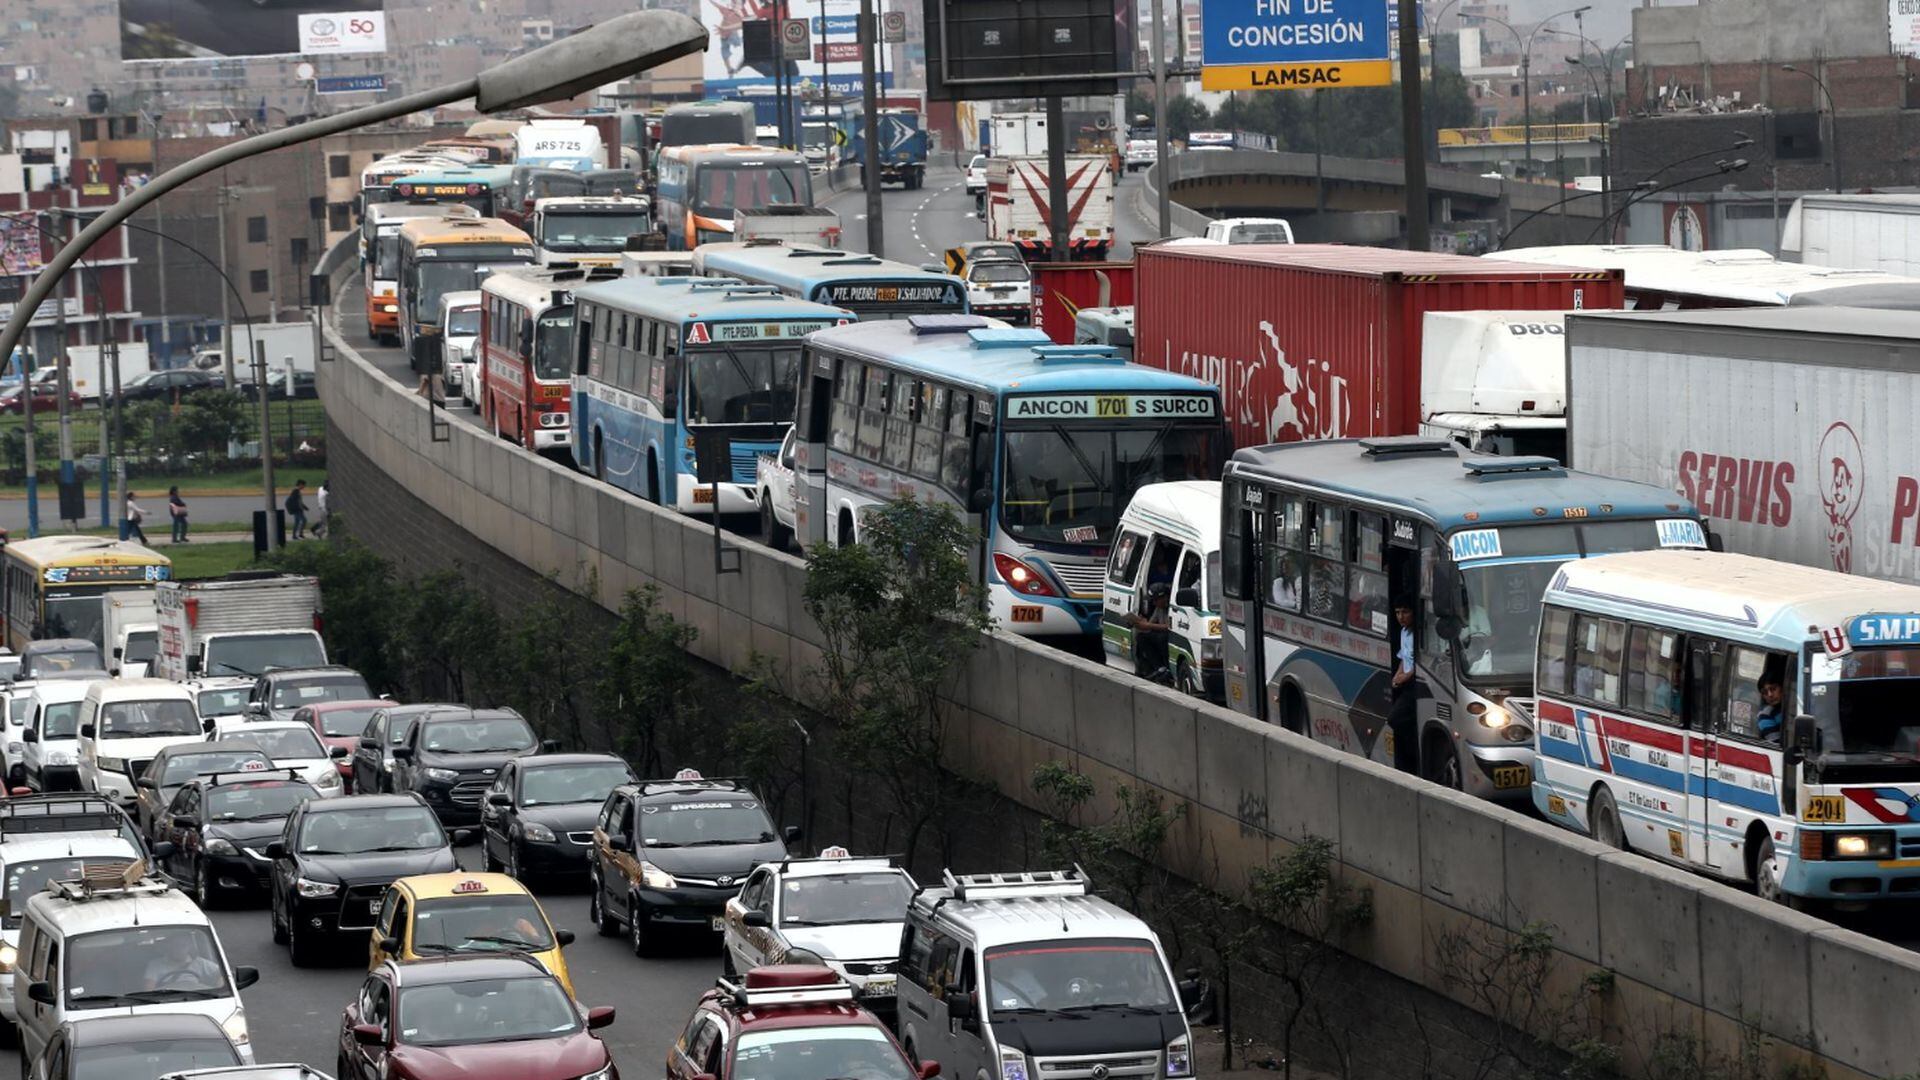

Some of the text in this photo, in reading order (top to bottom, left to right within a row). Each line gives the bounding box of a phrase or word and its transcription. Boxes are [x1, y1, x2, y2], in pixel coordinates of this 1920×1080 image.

[1257, 0, 1333, 16] FIN DE
[350, 19, 374, 34] 50
[787, 26, 801, 36] 40
[1228, 18, 1364, 47] CONCESIÓN
[852, 79, 882, 92] Noe
[1251, 67, 1341, 86] LAMSAC
[1034, 297, 1044, 329] BAR
[1017, 398, 1209, 416] ANCON 1701 S SURCO
[1677, 450, 1795, 528] SERVIS
[1889, 475, 1920, 548] P
[1453, 531, 1499, 558] ANCON
[1013, 606, 1042, 621] 1701
[1823, 627, 1845, 654] U
[1495, 769, 1526, 787] 1517
[1807, 799, 1841, 820] 2204
[825, 850, 846, 858] TAXI
[460, 883, 481, 891] TAXI
